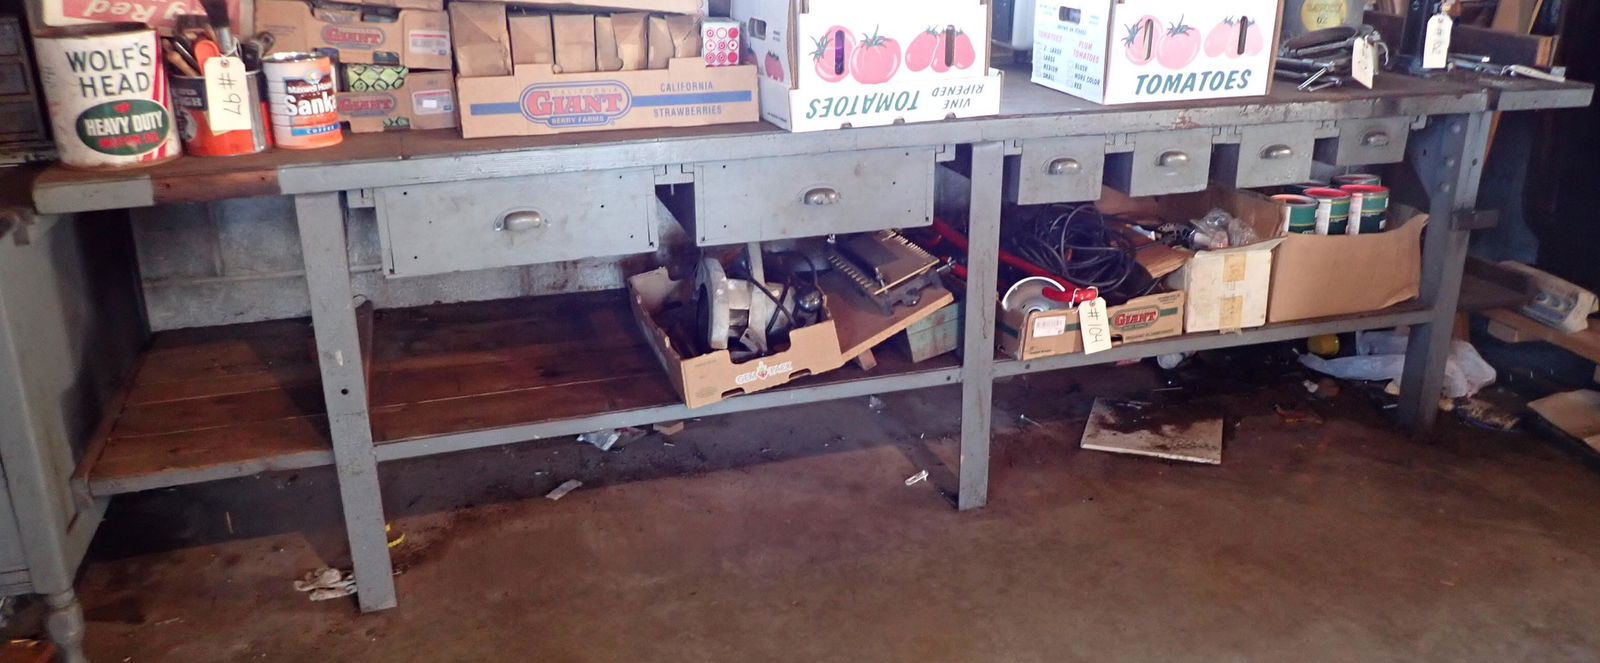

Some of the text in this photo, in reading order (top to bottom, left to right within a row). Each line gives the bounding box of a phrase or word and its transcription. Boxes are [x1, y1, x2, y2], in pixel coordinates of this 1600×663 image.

[82, 0, 157, 22] Red
[65, 42, 152, 73] WOLF'S
[79, 72, 150, 98] HEAD
[660, 80, 714, 93] CALIFORNIA
[931, 83, 986, 98] RIPENED
[1134, 68, 1253, 96] TOMATOES
[526, 90, 623, 117] GIANT
[653, 104, 723, 118] STRAWBERRIES
[805, 89, 921, 120] TOMATOES
[943, 97, 972, 110] VINE
[84, 110, 163, 137] HEAVY DUTY
[1114, 309, 1158, 328] GIANT
